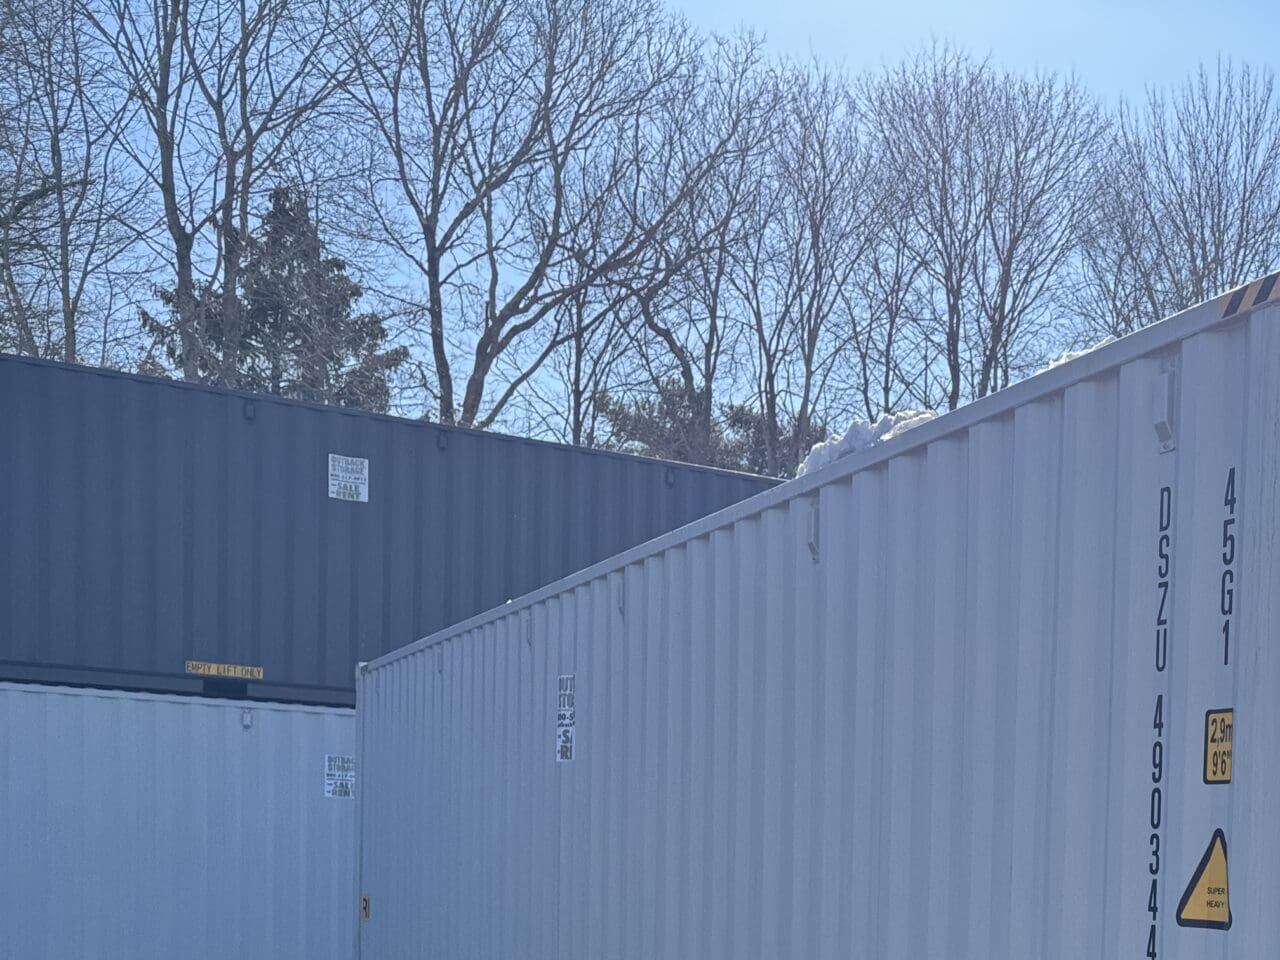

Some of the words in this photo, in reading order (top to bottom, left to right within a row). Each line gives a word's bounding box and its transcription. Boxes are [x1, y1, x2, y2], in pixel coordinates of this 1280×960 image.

[1221, 467, 1236, 665] 45G1
[1155, 487, 1171, 672] DSZU
[186, 662, 211, 674] EMPTY
[216, 664, 236, 676] LIFT
[241, 666, 261, 678] ONLY
[1207, 886, 1226, 895] SUPER
[1206, 900, 1225, 909] HEAVY
